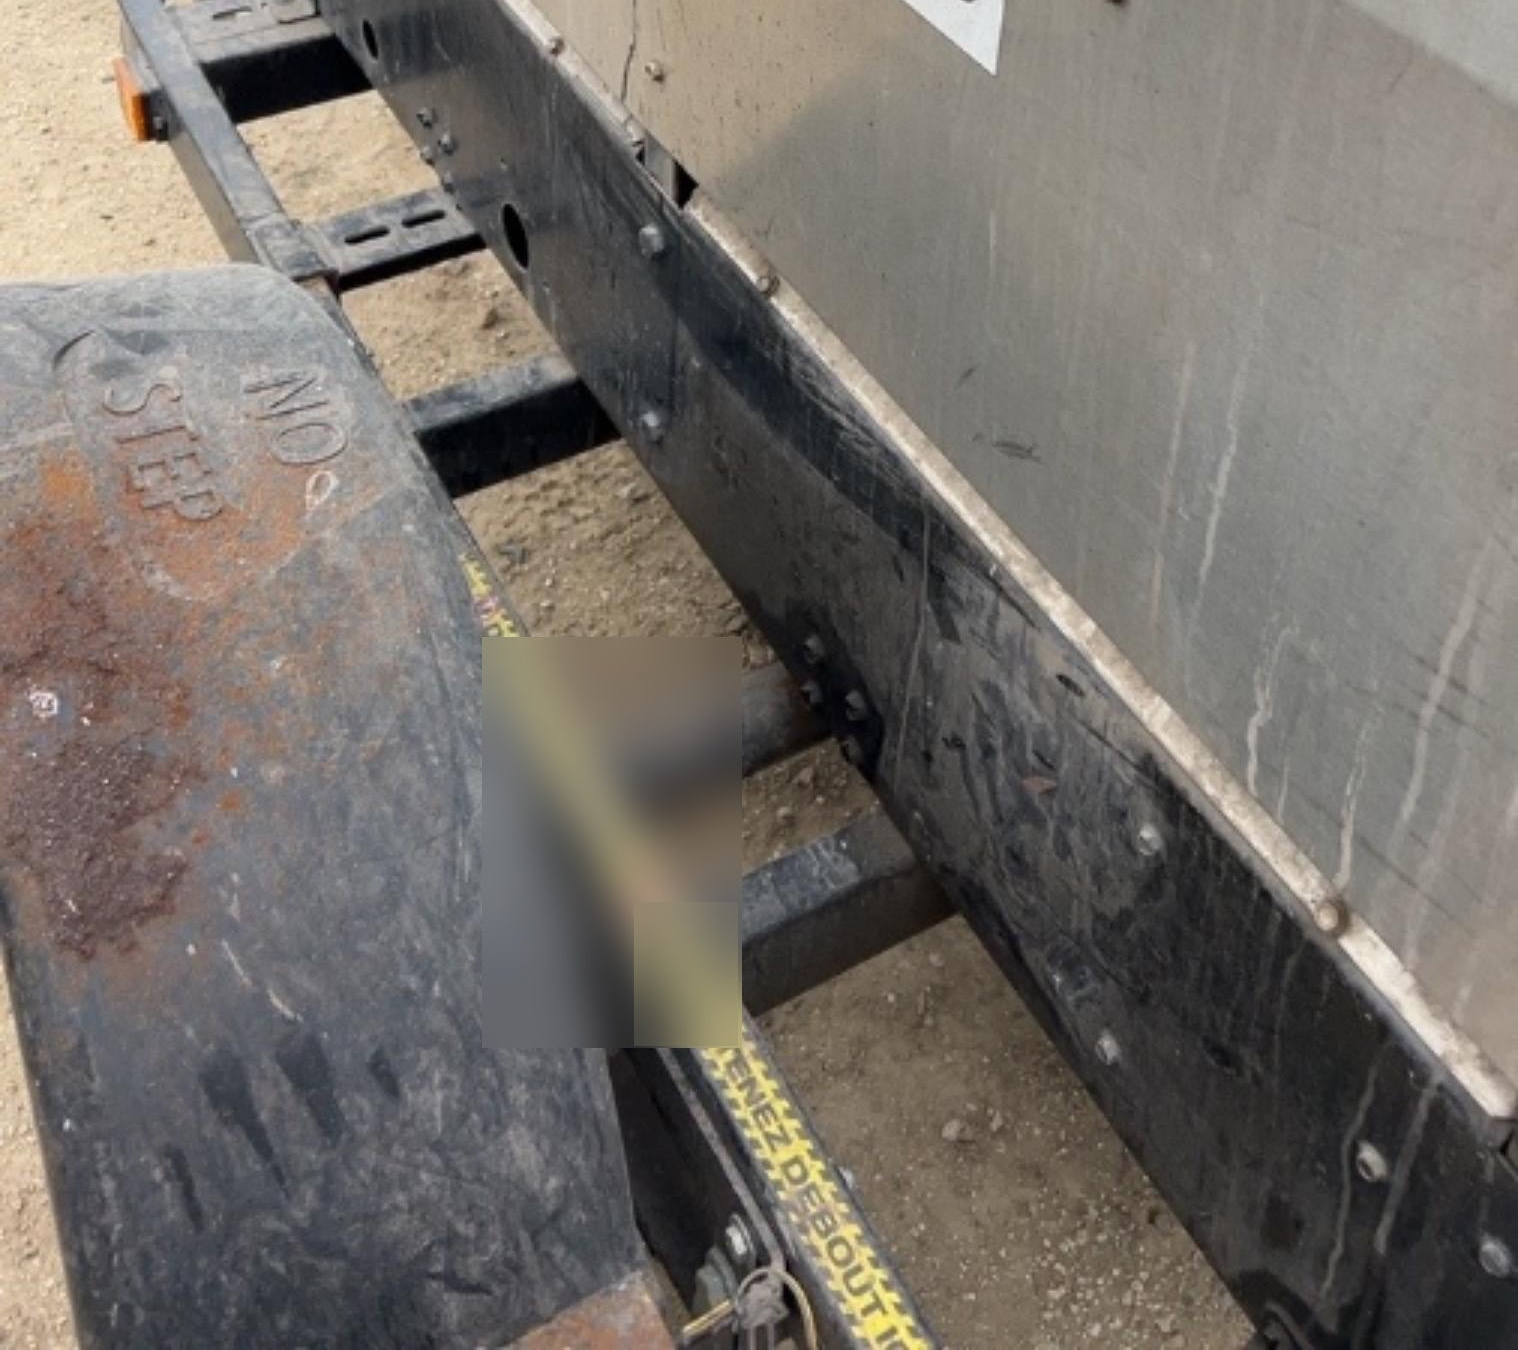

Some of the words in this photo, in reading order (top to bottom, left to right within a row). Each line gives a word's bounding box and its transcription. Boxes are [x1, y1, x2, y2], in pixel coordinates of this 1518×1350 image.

[101, 378, 226, 523] STEP
[240, 365, 348, 467] NO
[781, 1154, 889, 1318] DEBOUT
